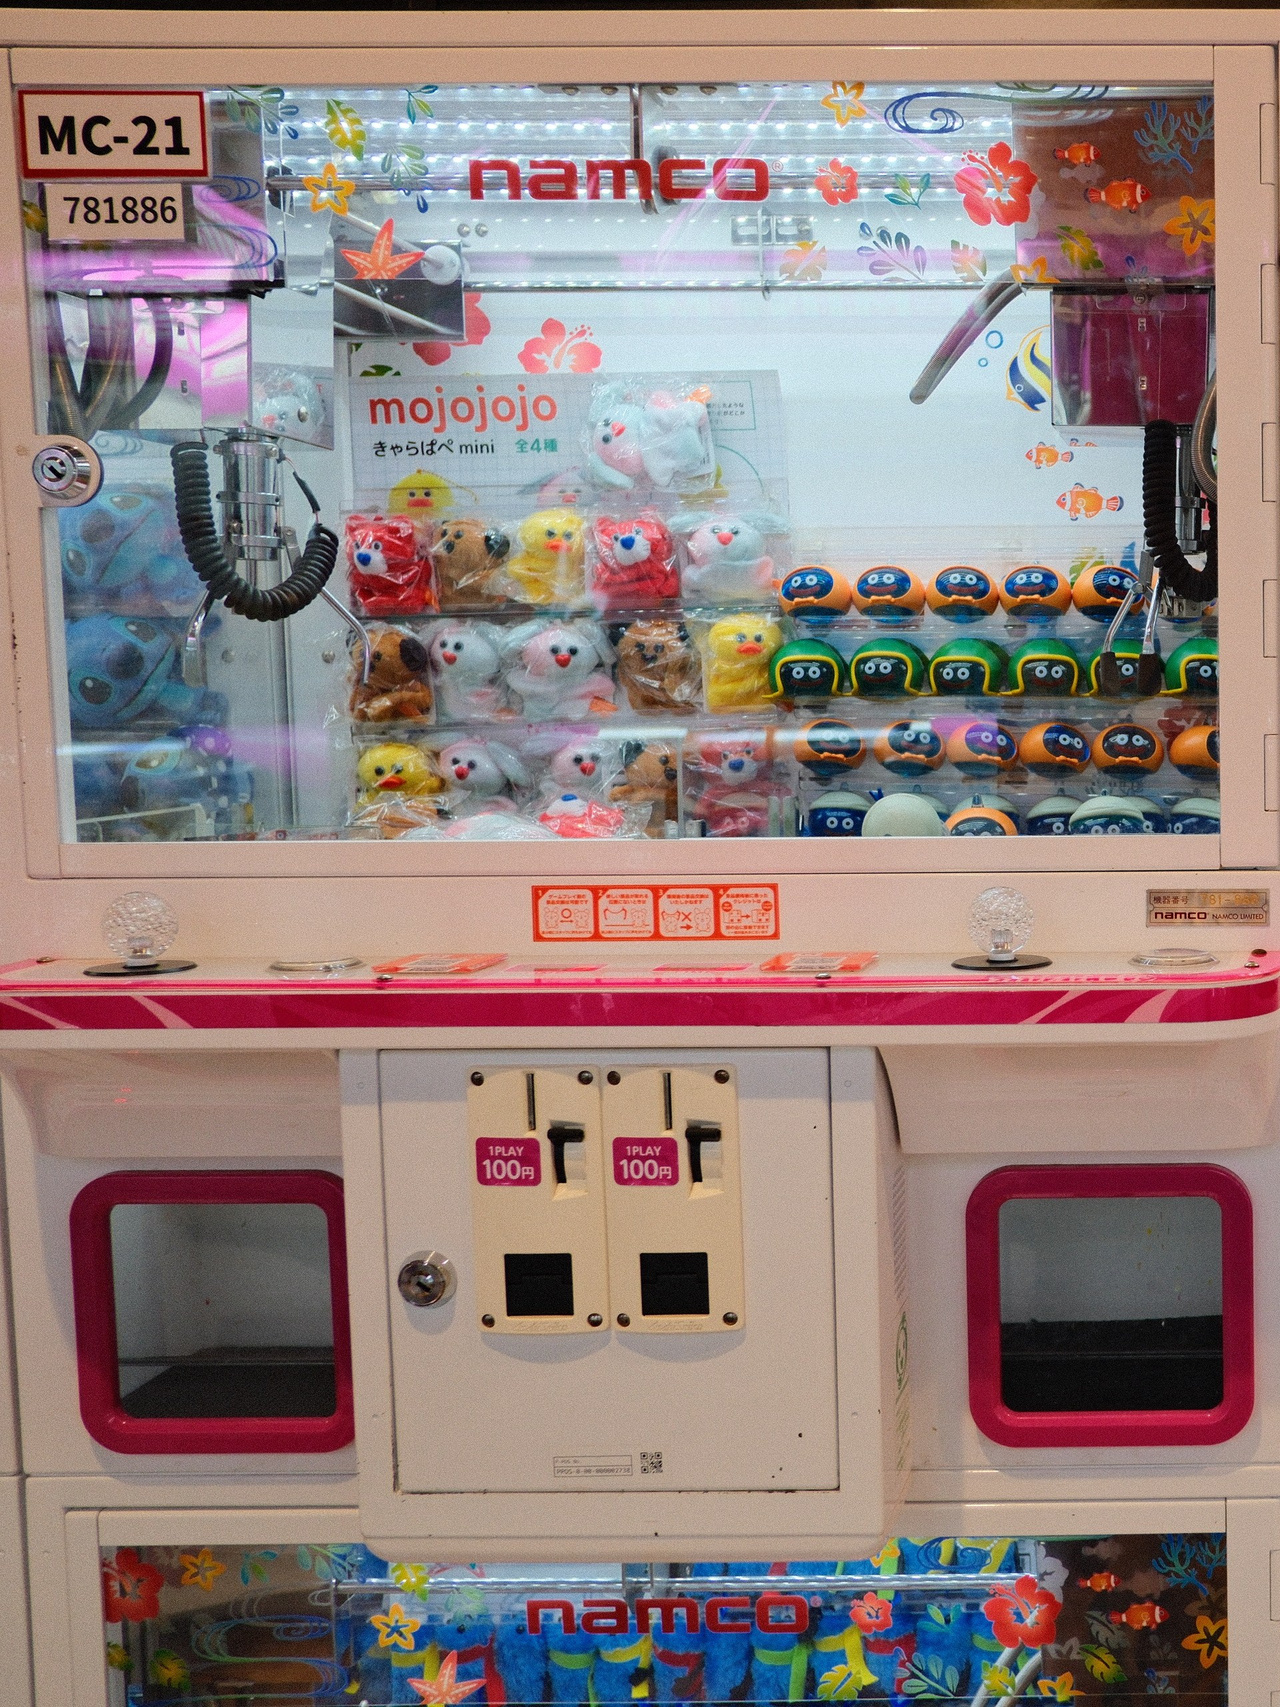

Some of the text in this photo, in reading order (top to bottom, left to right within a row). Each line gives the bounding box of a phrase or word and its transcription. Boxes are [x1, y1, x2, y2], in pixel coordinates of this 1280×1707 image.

[38, 115, 190, 156] MC-21
[470, 159, 768, 200] namco
[63, 196, 177, 224] 781886
[368, 384, 558, 433] mojojojo
[459, 439, 495, 455] mini
[515, 437, 558, 453] 全4種
[1153, 896, 1189, 905] 機器番号
[1155, 911, 1207, 920] namco
[488, 1146, 524, 1157] 1PLAY
[626, 1145, 662, 1156] 1PLAY
[482, 1159, 535, 1180] 100円
[619, 1159, 672, 1180] 100円
[526, 1598, 809, 1633] namco
